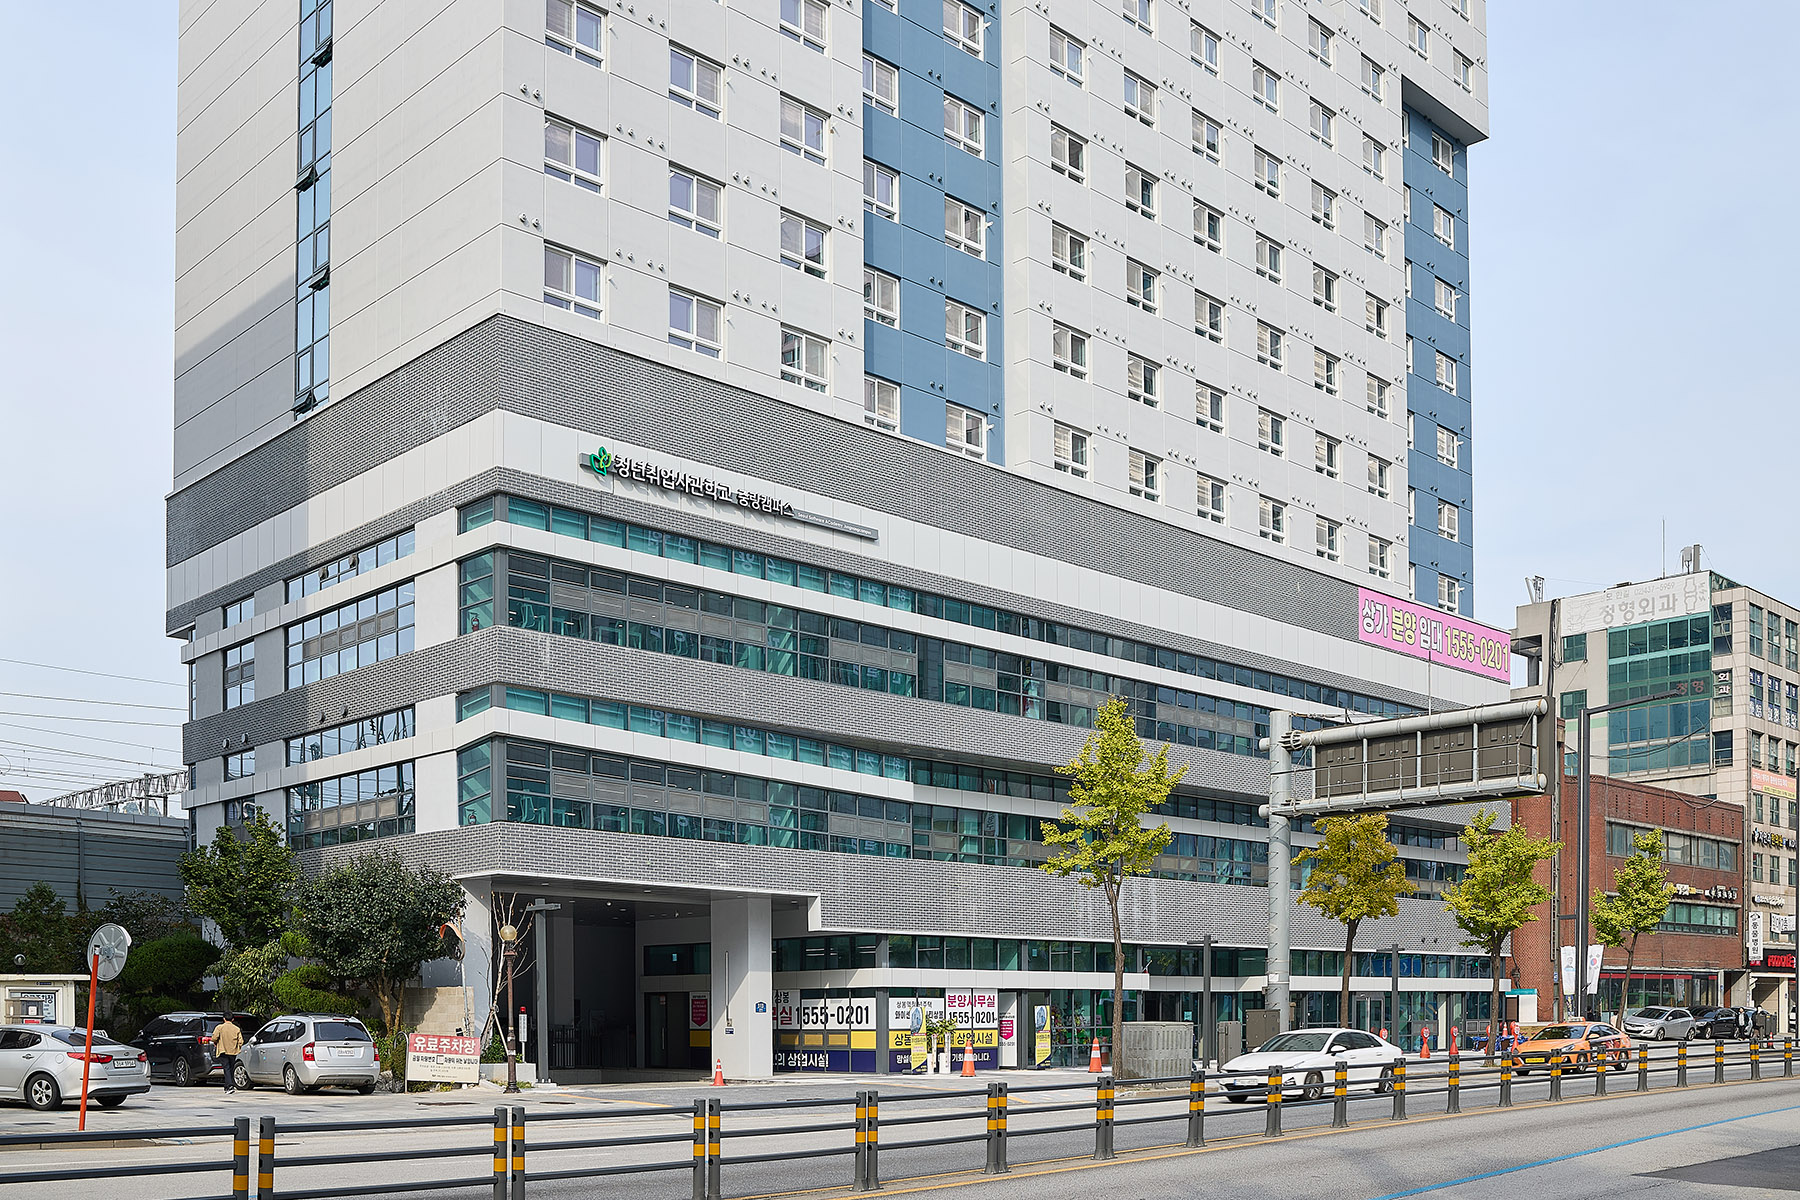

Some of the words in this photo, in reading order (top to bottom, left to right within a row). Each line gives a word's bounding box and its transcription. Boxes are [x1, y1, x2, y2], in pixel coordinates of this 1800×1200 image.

[614, 454, 733, 501] 청년취업사관학교
[736, 488, 796, 517] 중랑캠퍼스
[1600, 592, 1678, 625] 정형외과
[1362, 599, 1389, 638] 상가
[1391, 606, 1417, 645] 분양
[1419, 616, 1443, 654] 임대
[1444, 626, 1509, 673] 1555-0201
[947, 994, 996, 1008] 분양사무실
[795, 1005, 869, 1025] 1555-0201
[948, 1011, 996, 1024] 1555-0201
[413, 1036, 476, 1054] 유료주차장
